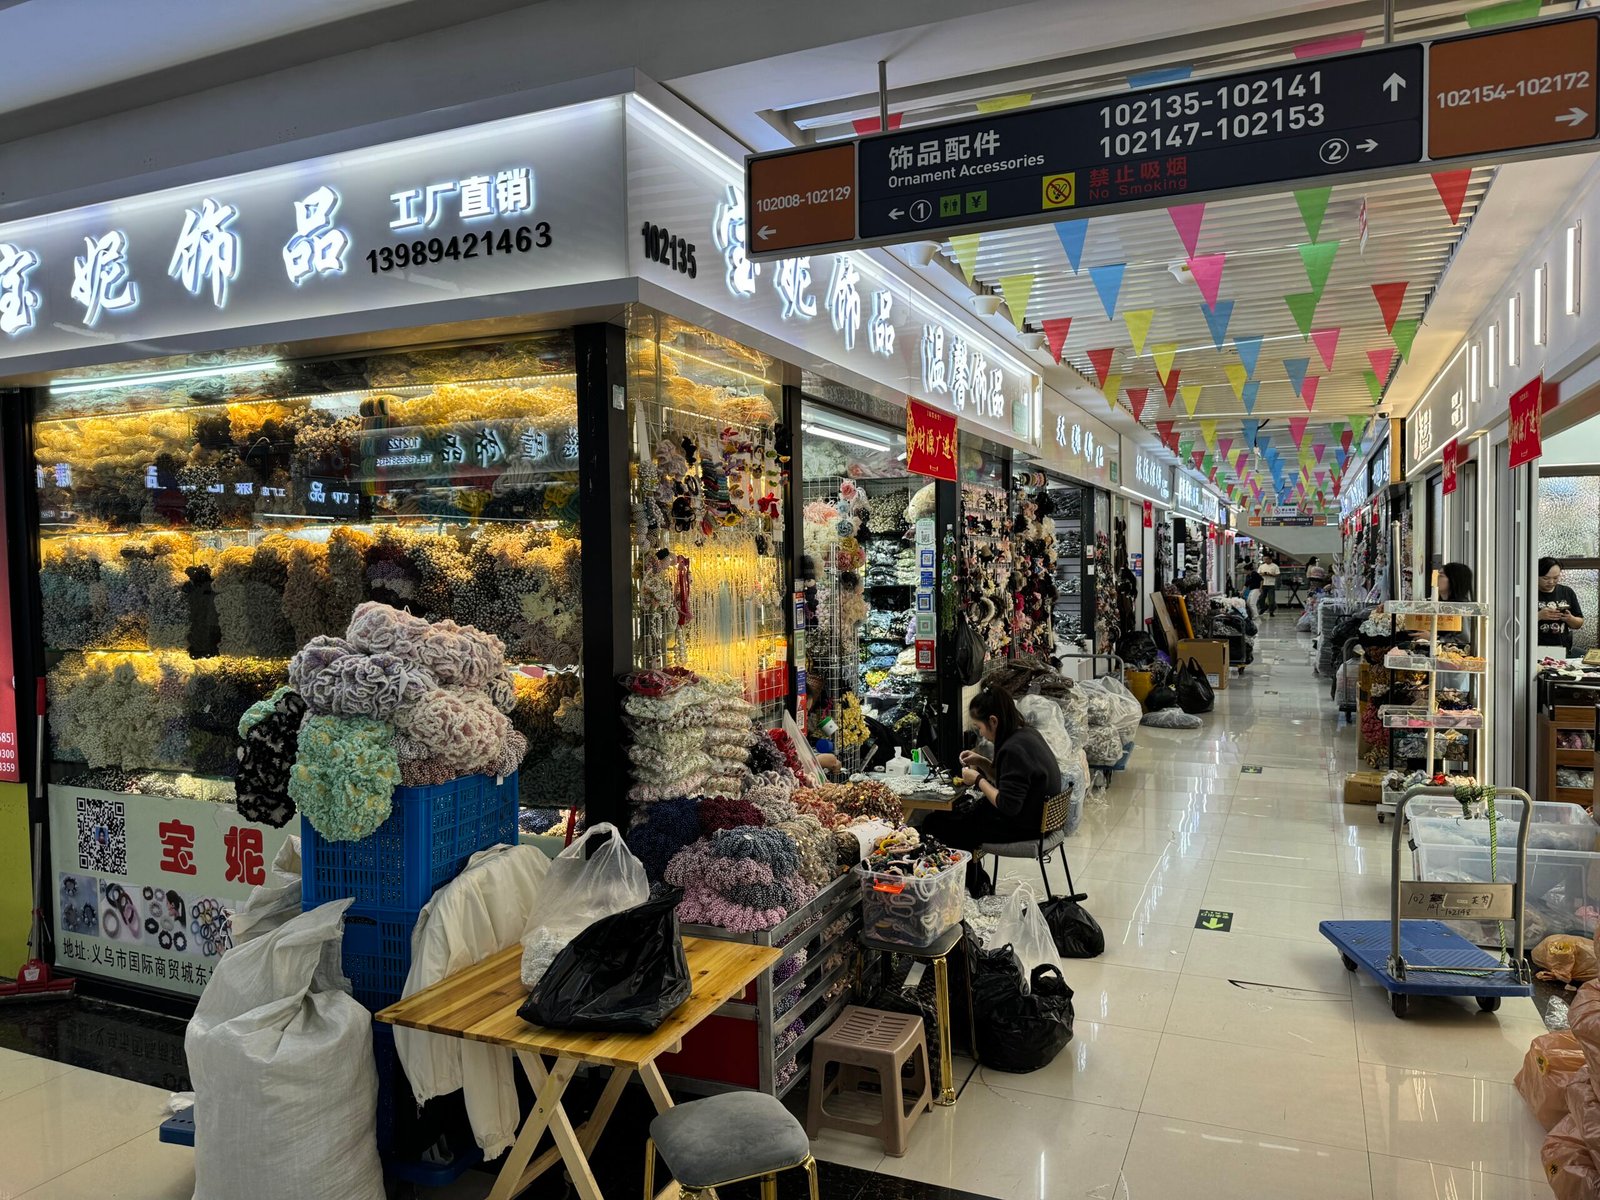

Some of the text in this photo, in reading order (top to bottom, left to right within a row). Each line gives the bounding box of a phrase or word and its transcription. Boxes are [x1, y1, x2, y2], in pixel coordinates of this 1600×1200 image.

[1099, 71, 1323, 129] 102135-102141
[1436, 70, 1591, 110] 102154-102172
[888, 129, 1001, 172] 饰品配件
[1099, 103, 1326, 160] 102147-102153
[888, 153, 1046, 189] Ornament Accessories
[1088, 155, 1188, 189] 禁止吸烟
[1088, 174, 1189, 201] No Smoking
[389, 167, 533, 230] 工厂直销
[756, 186, 852, 214] 102008-102129
[365, 221, 554, 274] 13989421463
[642, 220, 697, 280] 102135
[916, 425, 952, 460] 财源广进
[0, 732, 14, 746] 85]
[158, 818, 266, 887] 宝妮
